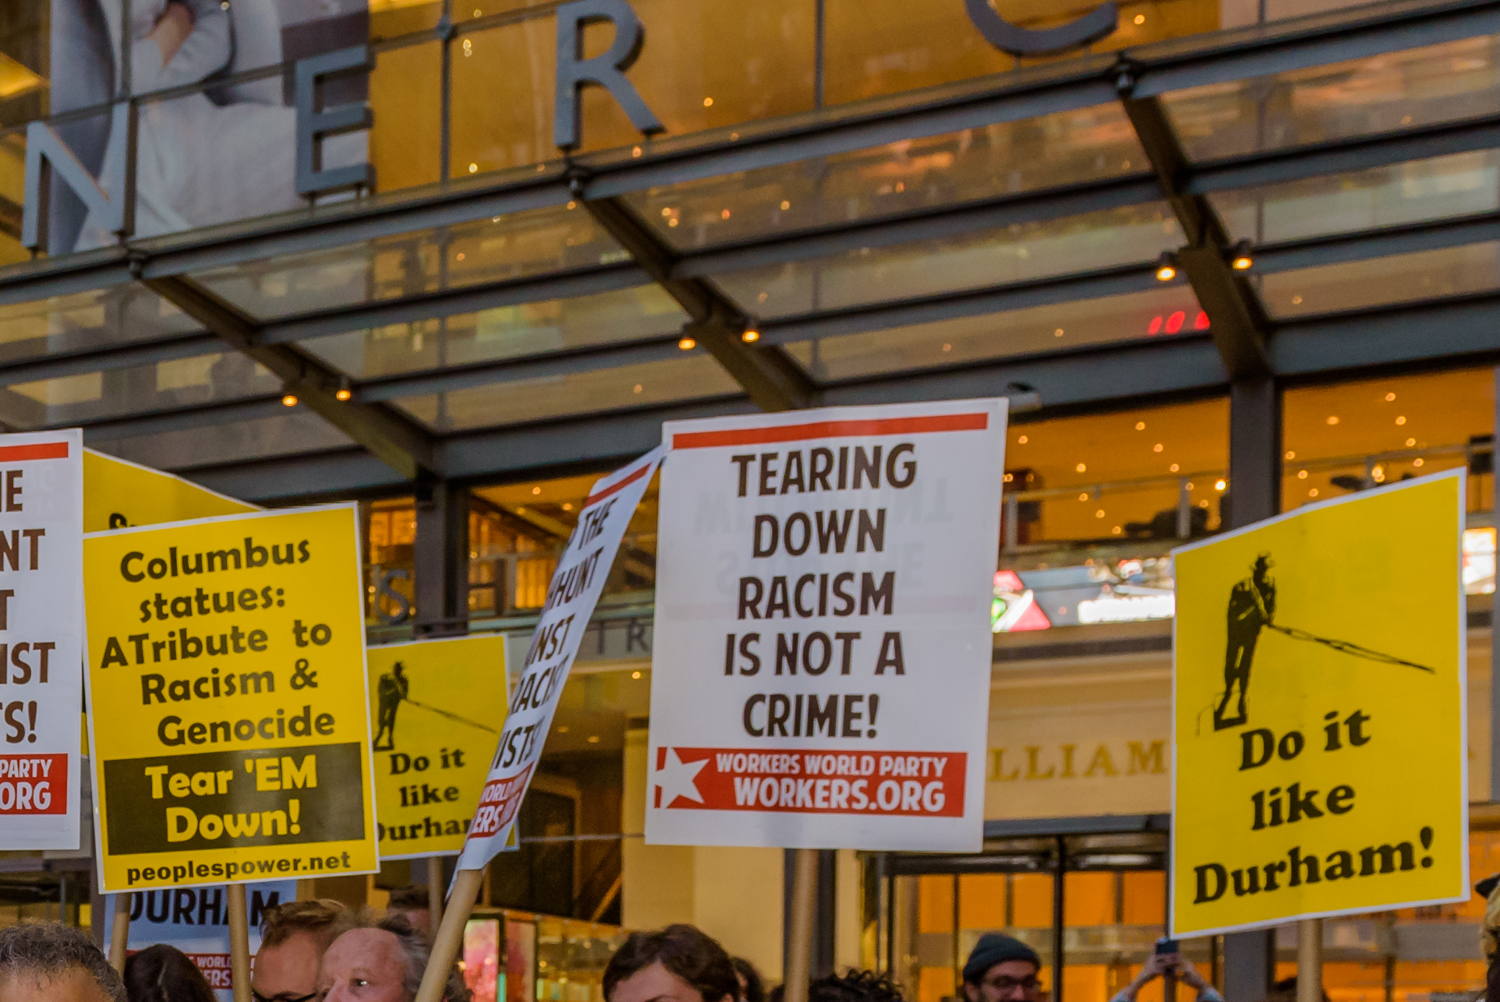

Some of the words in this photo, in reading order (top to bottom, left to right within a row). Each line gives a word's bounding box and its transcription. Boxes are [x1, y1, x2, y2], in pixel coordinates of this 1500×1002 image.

[731, 443, 917, 497] TEARING
[580, 498, 618, 550] THE
[753, 508, 886, 559] DOWN
[120, 537, 310, 582] Columbus
[140, 585, 285, 622] statues:
[738, 571, 896, 620] RACISM
[292, 620, 332, 648] to
[724, 632, 761, 676] IS
[774, 632, 861, 676] NOT
[874, 632, 906, 676] A
[141, 668, 274, 706] Racism
[290, 658, 318, 689] &
[157, 705, 336, 747] Genocide
[743, 693, 880, 739] CRIME!
[390, 753, 430, 775] Do
[440, 747, 466, 769] it
[989, 740, 1166, 782] LLIAM
[1238, 726, 1305, 771] Do
[1324, 709, 1372, 752] it
[144, 765, 234, 800] Tear
[244, 754, 318, 792] 'EM
[716, 753, 800, 775] WORKERS
[804, 754, 875, 776] WORLD
[879, 756, 947, 777] PARTY
[399, 784, 459, 808] like
[734, 778, 944, 812] WORKERS.ORG
[1251, 782, 1356, 832] like
[166, 798, 300, 842] Down!
[127, 851, 350, 886] peoplespower.net
[1193, 826, 1435, 904] Durham!
